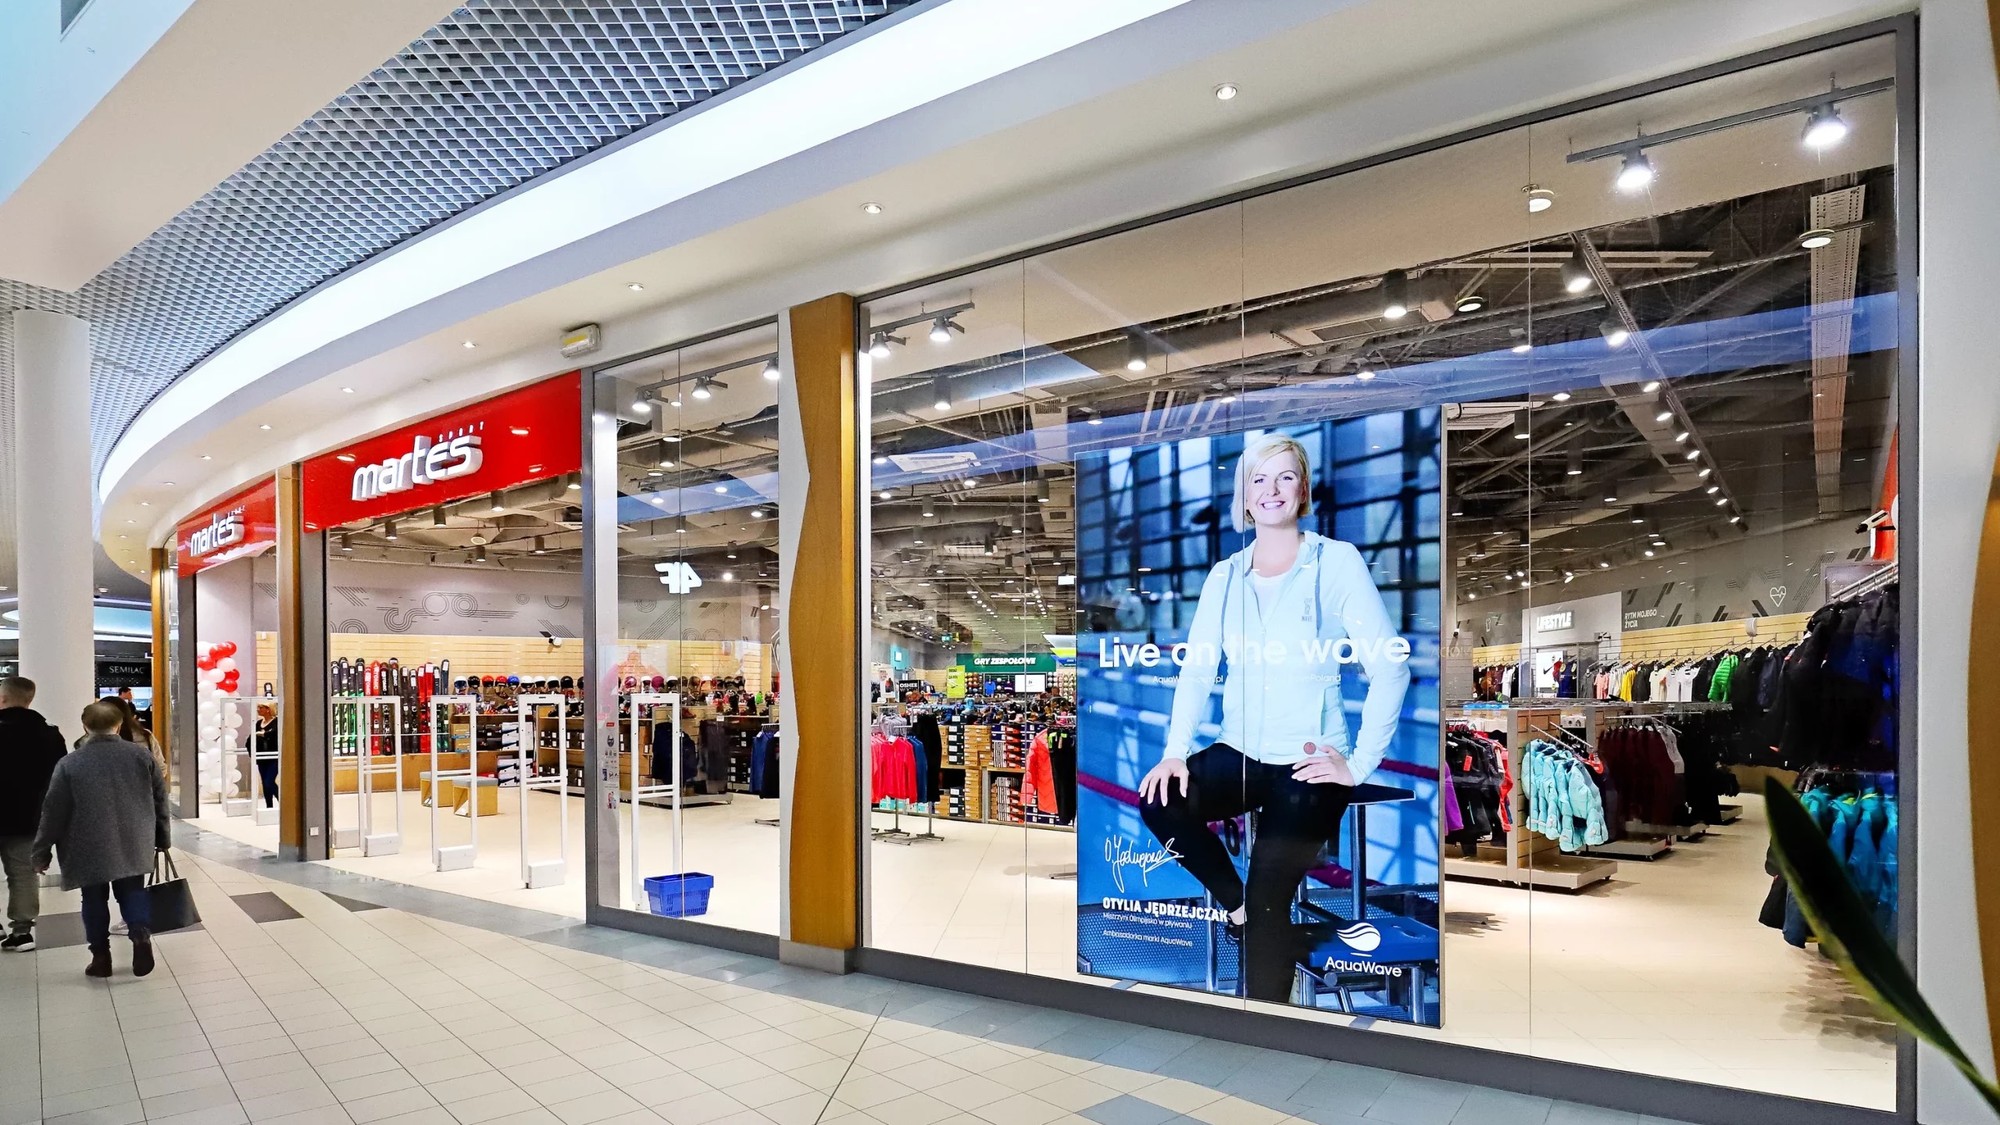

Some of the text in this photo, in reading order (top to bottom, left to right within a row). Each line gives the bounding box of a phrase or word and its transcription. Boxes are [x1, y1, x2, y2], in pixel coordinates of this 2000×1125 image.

[351, 435, 483, 501] martes
[190, 512, 245, 557] martes
[1536, 611, 1572, 630] LIFESTYLE
[973, 657, 990, 665] GRY
[1099, 633, 1411, 668] Live on the wave
[109, 665, 144, 674] SEMILAC
[1103, 896, 1229, 922] OTYLIA JĘDRZEJCZAK
[1324, 956, 1402, 977] AquaWave
